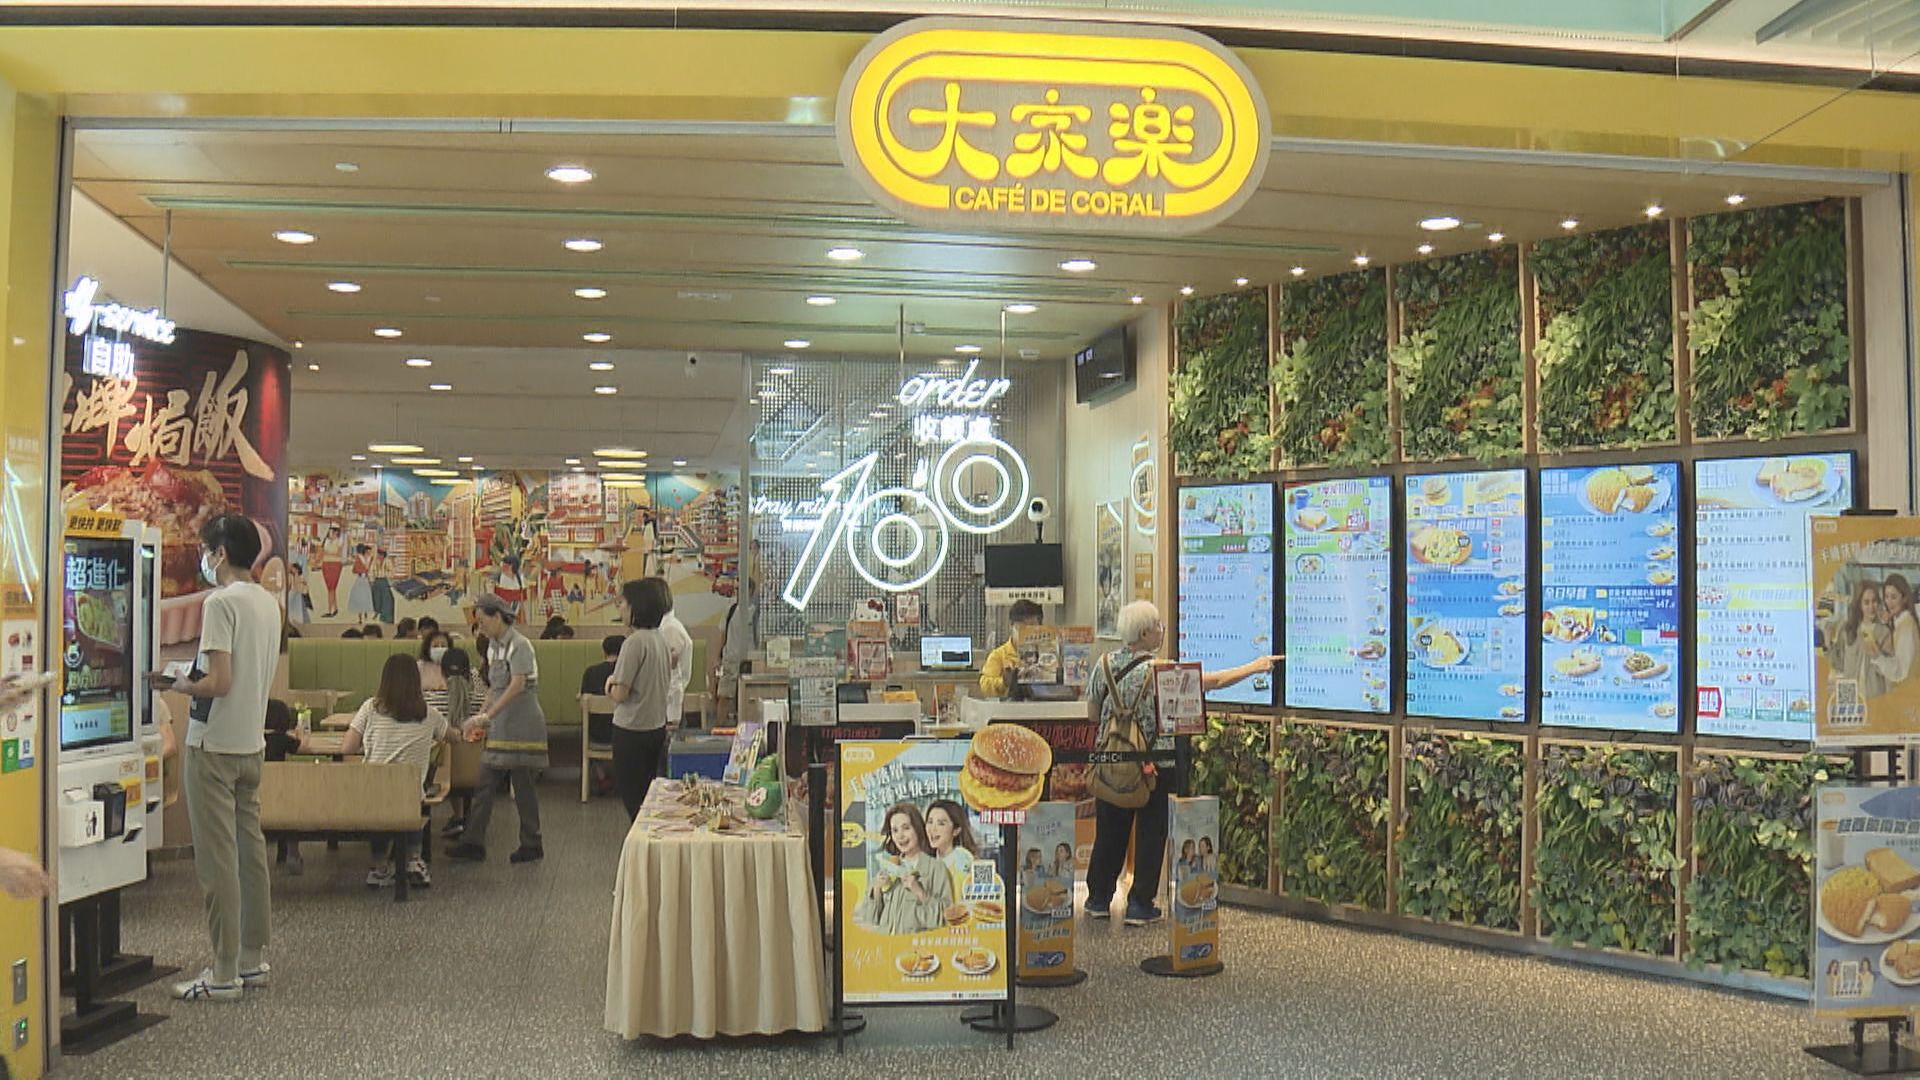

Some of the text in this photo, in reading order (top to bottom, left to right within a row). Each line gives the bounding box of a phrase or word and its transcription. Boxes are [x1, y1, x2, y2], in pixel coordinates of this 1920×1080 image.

[955, 183, 1163, 217] CAFÉ DE CORAL
[899, 357, 1011, 407] order
[63, 349, 275, 482] 牌焗飯
[66, 556, 126, 591] 超進化
